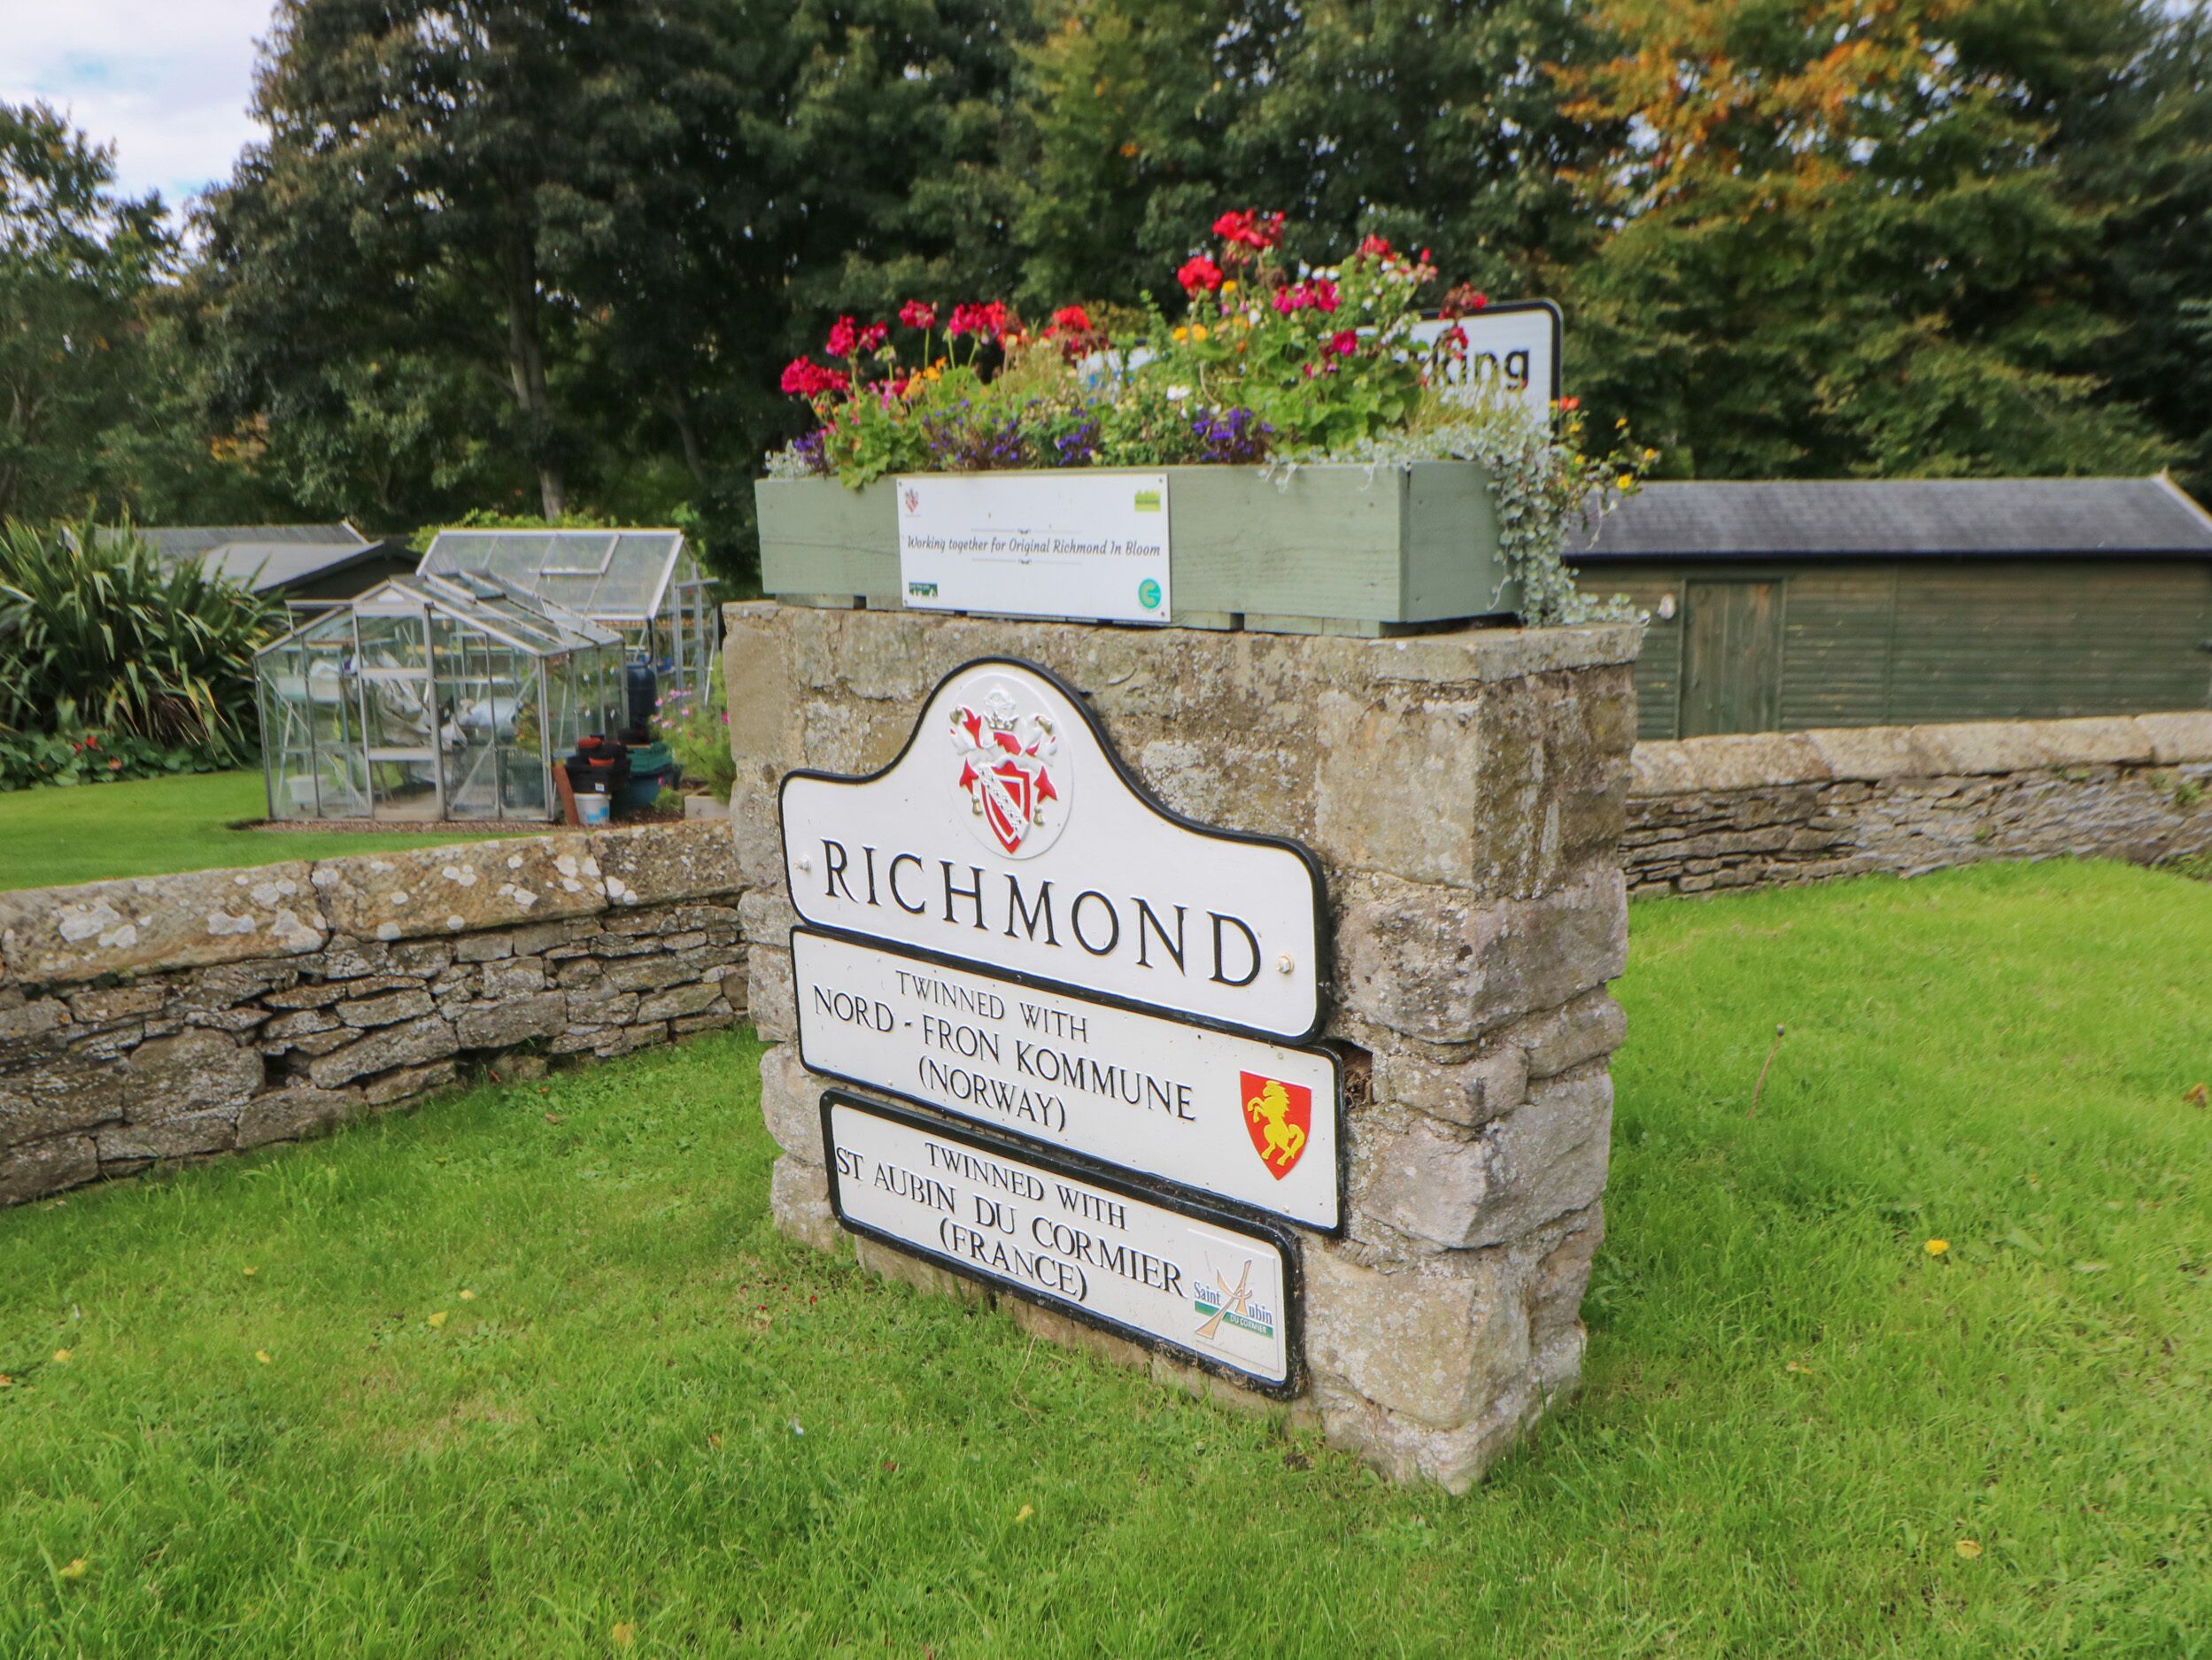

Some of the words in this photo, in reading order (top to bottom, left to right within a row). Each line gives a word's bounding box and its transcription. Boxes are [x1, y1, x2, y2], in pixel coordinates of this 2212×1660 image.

[908, 535, 946, 553] Working
[949, 536, 988, 554] together
[991, 537, 1006, 553] for
[1009, 537, 1049, 556] Original
[1053, 538, 1108, 555] Richmond
[1110, 540, 1121, 555] In
[1125, 540, 1160, 556] Bloom
[820, 838, 1263, 987] RICHMOND
[896, 969, 1004, 1020] TWINNED
[1019, 1001, 1088, 1043] WITH
[813, 984, 894, 1033] NORD
[923, 1013, 1000, 1065] FRON
[1016, 1038, 1196, 1122] KOMMUNE
[919, 1054, 1066, 1133] (NORWAY)
[836, 1147, 865, 1181] ST
[873, 1161, 957, 1215] AUBIN
[974, 1193, 1017, 1235] DU
[1032, 1216, 1188, 1300] CORMIER
[924, 1142, 1045, 1201] TWINNED
[1056, 1183, 1129, 1231] WITH
[940, 1216, 1088, 1302] (FRANCE)
[1194, 1281, 1221, 1307] Saint
[1230, 1315, 1240, 1324] DU
[1240, 1317, 1267, 1334] CORMIER
